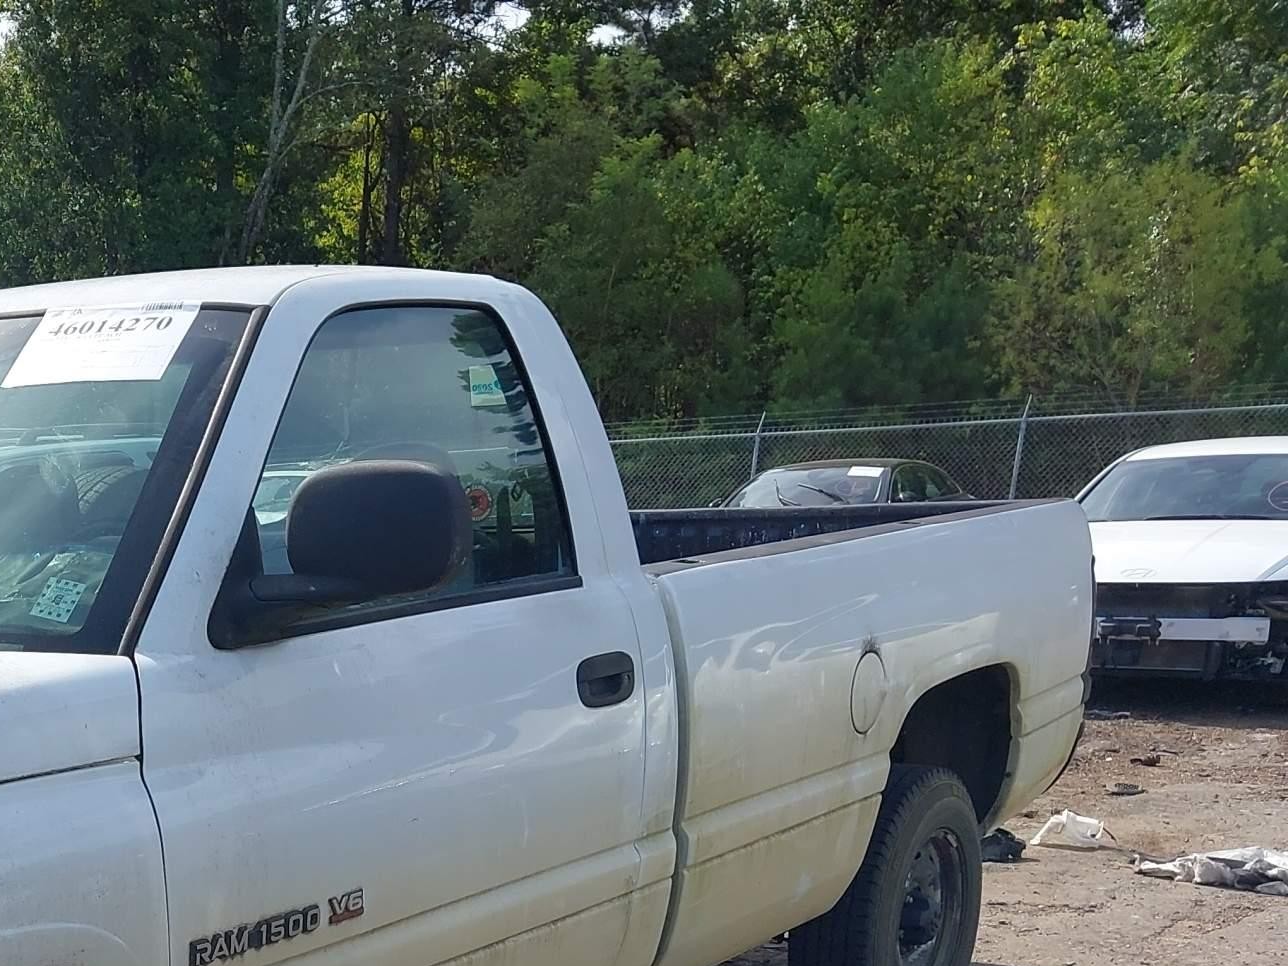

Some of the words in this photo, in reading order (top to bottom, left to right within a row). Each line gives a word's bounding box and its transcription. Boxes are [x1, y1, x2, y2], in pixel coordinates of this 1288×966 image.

[48, 315, 174, 337] 46014270
[255, 904, 321, 946] 1500
[328, 888, 365, 920] V6
